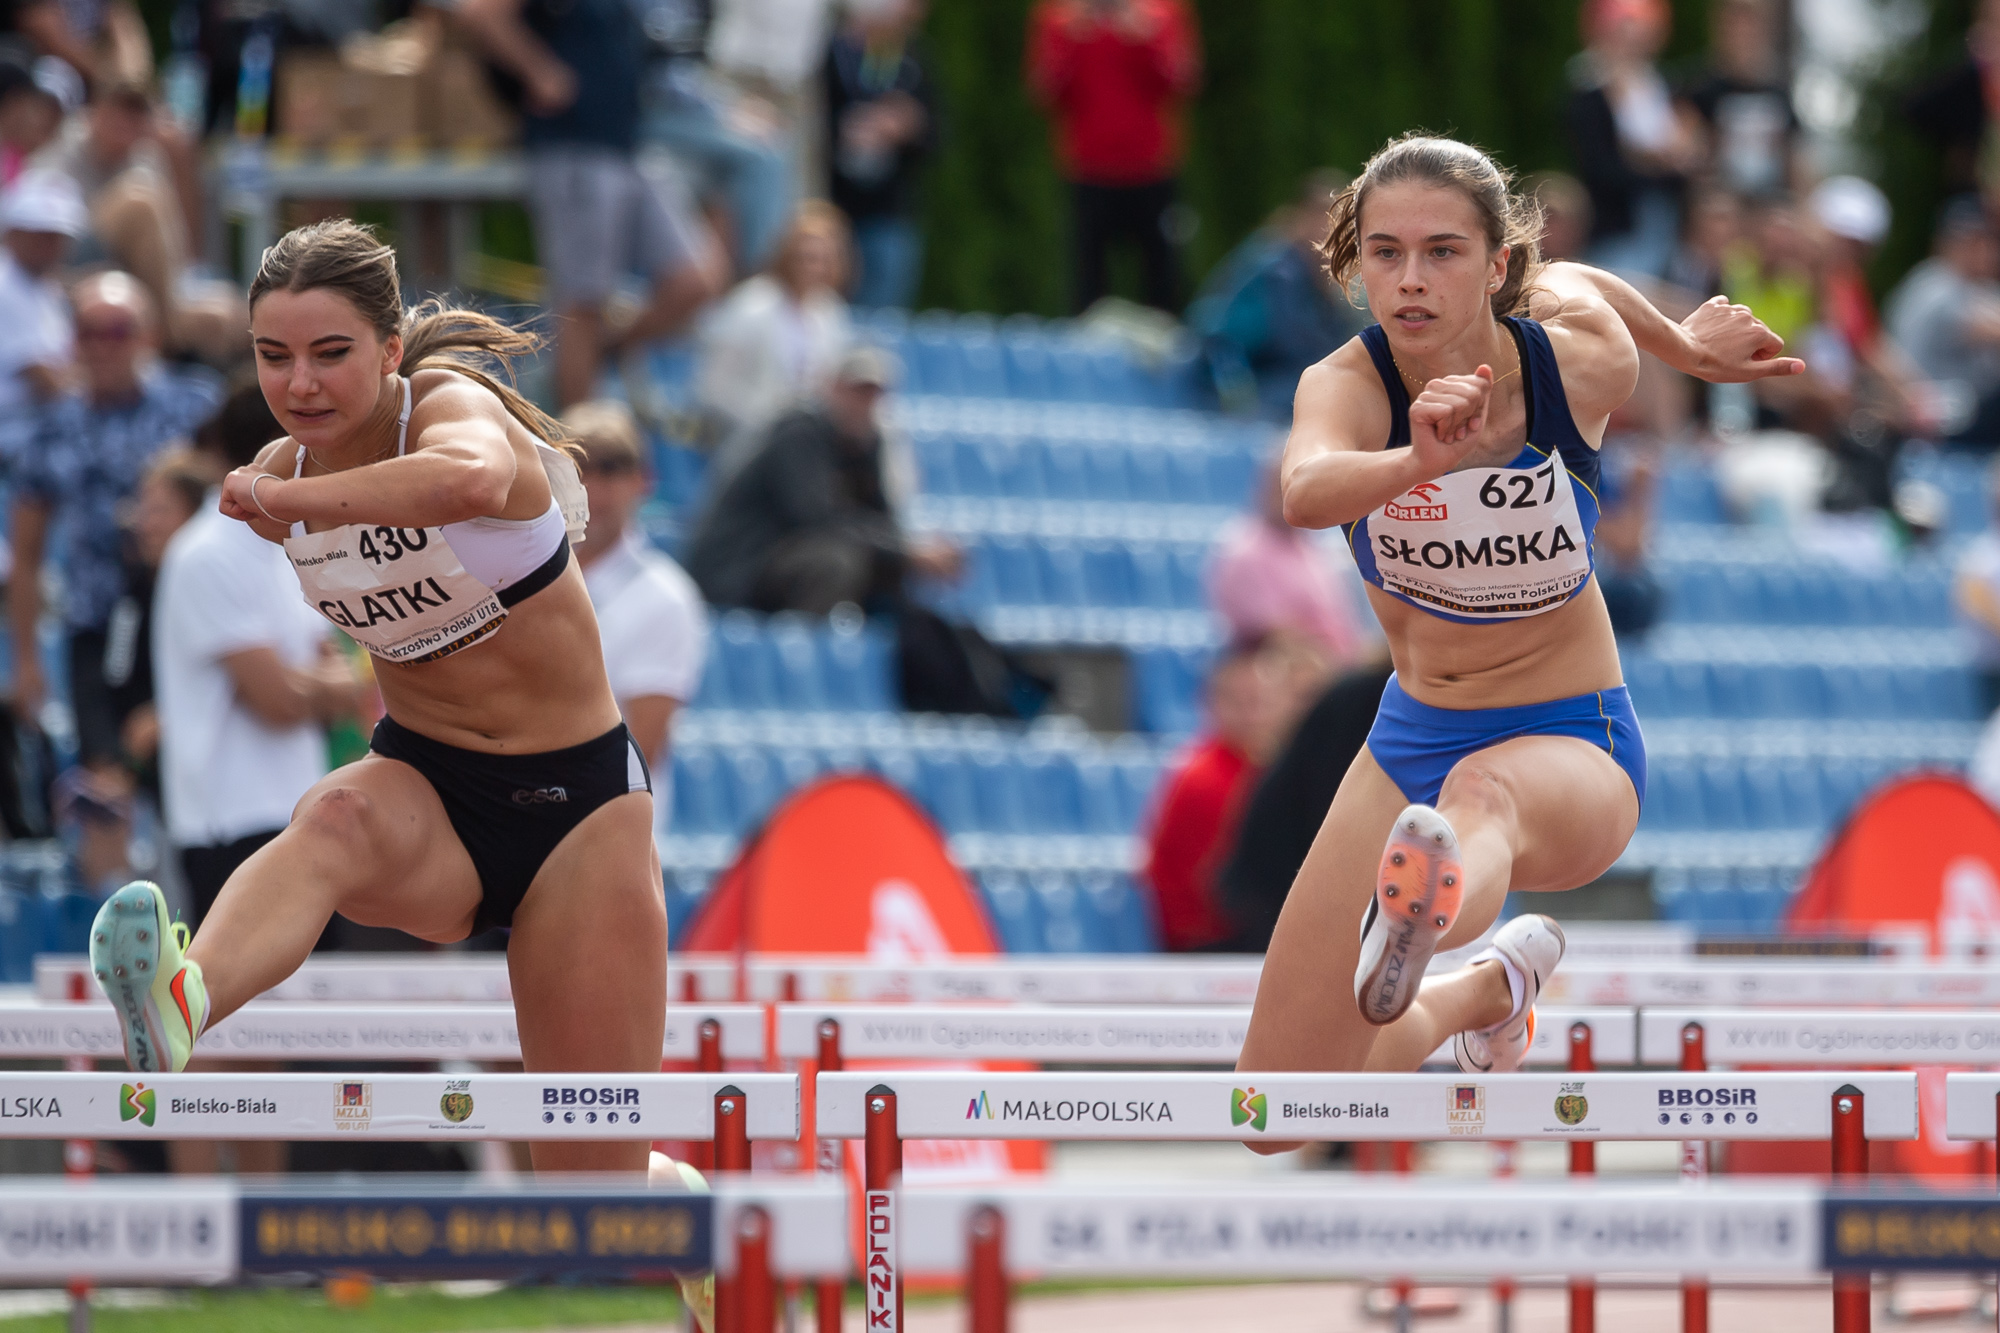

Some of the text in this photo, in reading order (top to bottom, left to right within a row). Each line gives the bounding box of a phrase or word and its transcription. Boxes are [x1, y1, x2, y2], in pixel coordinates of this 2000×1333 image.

[1479, 462, 1556, 509] 627
[1387, 504, 1443, 520] ORLEN
[359, 526, 428, 565] 430
[1378, 524, 1577, 570] SŁOMSKA
[318, 576, 452, 629] GLATKI
[1439, 588, 1516, 603] Mistrzostwa
[1521, 582, 1559, 599] Polski
[441, 612, 476, 637] Polski
[477, 601, 499, 620] U18
[171, 1098, 277, 1115] Bielsko-Biała
[542, 1088, 640, 1105] BBOSiR
[1658, 1088, 1757, 1106] BBOSiR
[0, 1098, 62, 1118] LSKA
[336, 1107, 369, 1118] MZLA
[1003, 1101, 1174, 1122] MAŁOPOLSKA
[1283, 1103, 1390, 1120] Bielsko-Biała
[1450, 1111, 1482, 1122] MZLA
[868, 1195, 893, 1328] POLANIK
